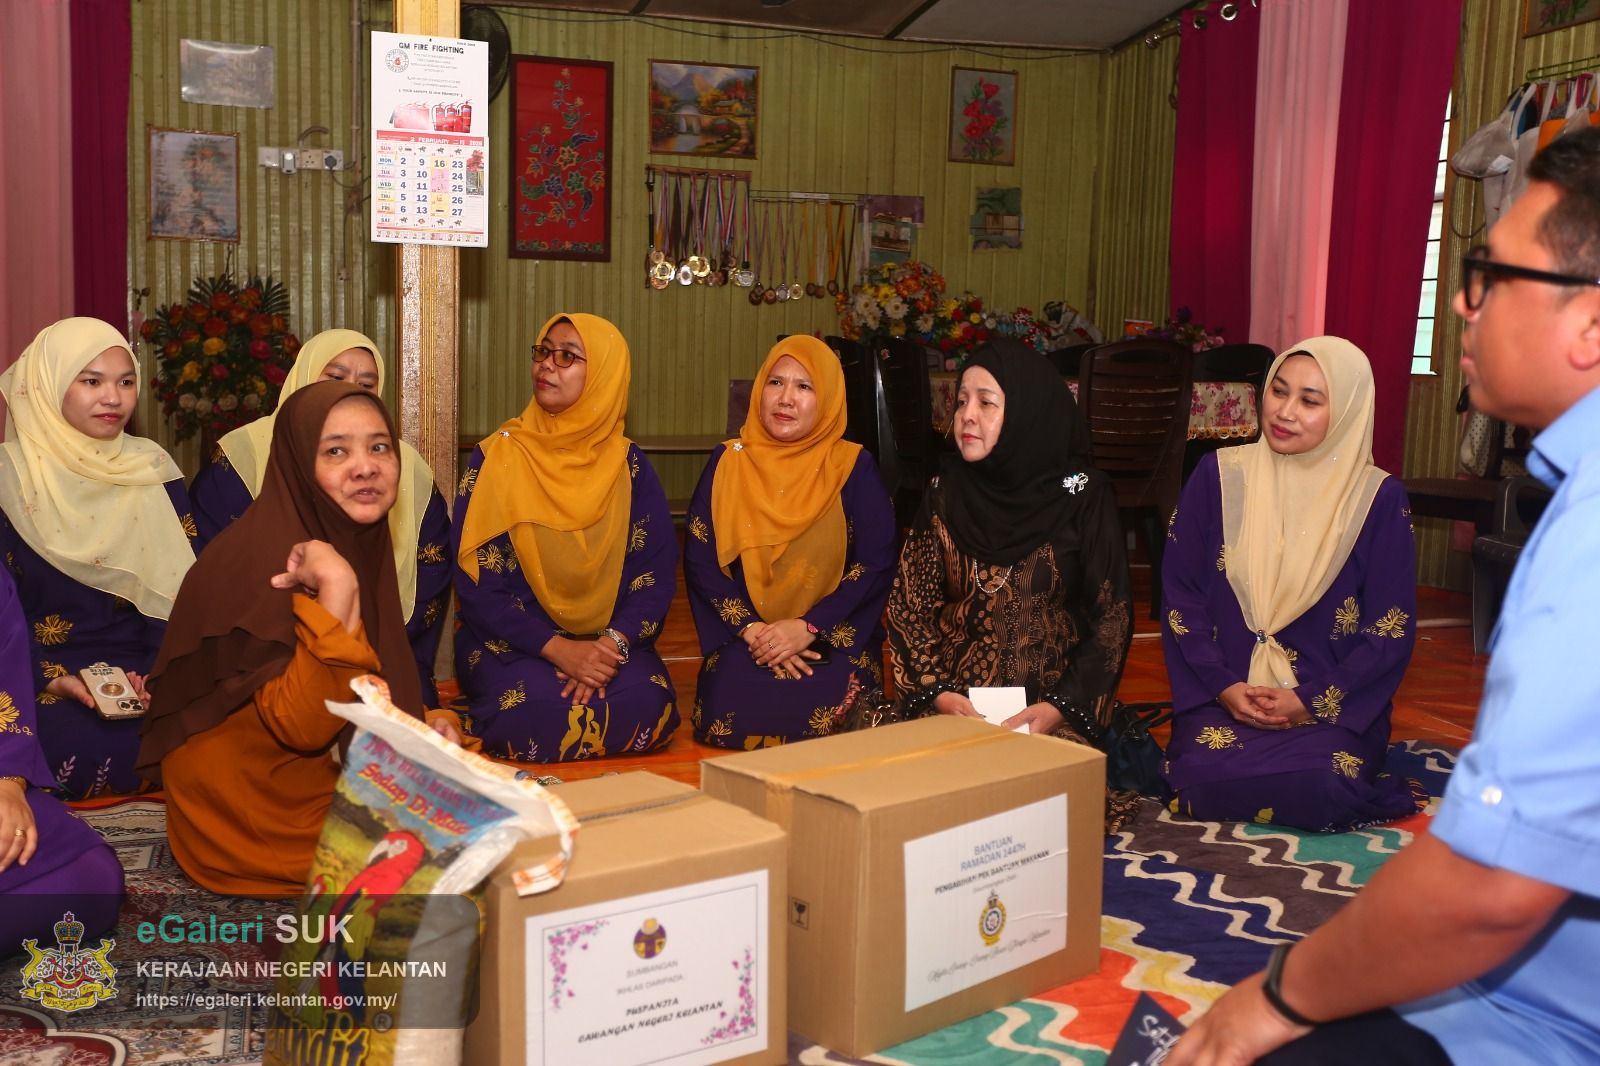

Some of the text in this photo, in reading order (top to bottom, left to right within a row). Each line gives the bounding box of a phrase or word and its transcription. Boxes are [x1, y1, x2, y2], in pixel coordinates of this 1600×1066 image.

[399, 42, 464, 54] GM FIRE FIGHTING
[418, 137, 449, 145] FEBRUARY
[400, 157, 406, 165] 2
[419, 158, 425, 166] 9
[434, 160, 445, 168] 16
[452, 161, 463, 169] 23
[400, 169, 406, 177] 3
[417, 170, 427, 178] 10
[400, 181, 406, 189] 4
[416, 182, 427, 190] 11
[400, 193, 406, 201] 5
[416, 194, 427, 202] 12
[452, 196, 463, 204] 26
[400, 205, 406, 213] 6
[416, 206, 427, 214] 13
[452, 208, 463, 216] 27
[973, 835, 1013, 857] BANTUAN
[960, 851, 1001, 872] RAMADAN
[626, 960, 678, 979] SUMBANGAN
[645, 974, 683, 990] DARIPADA
[577, 1000, 723, 1044] CAWANGAN NEGERI KELANTAN
